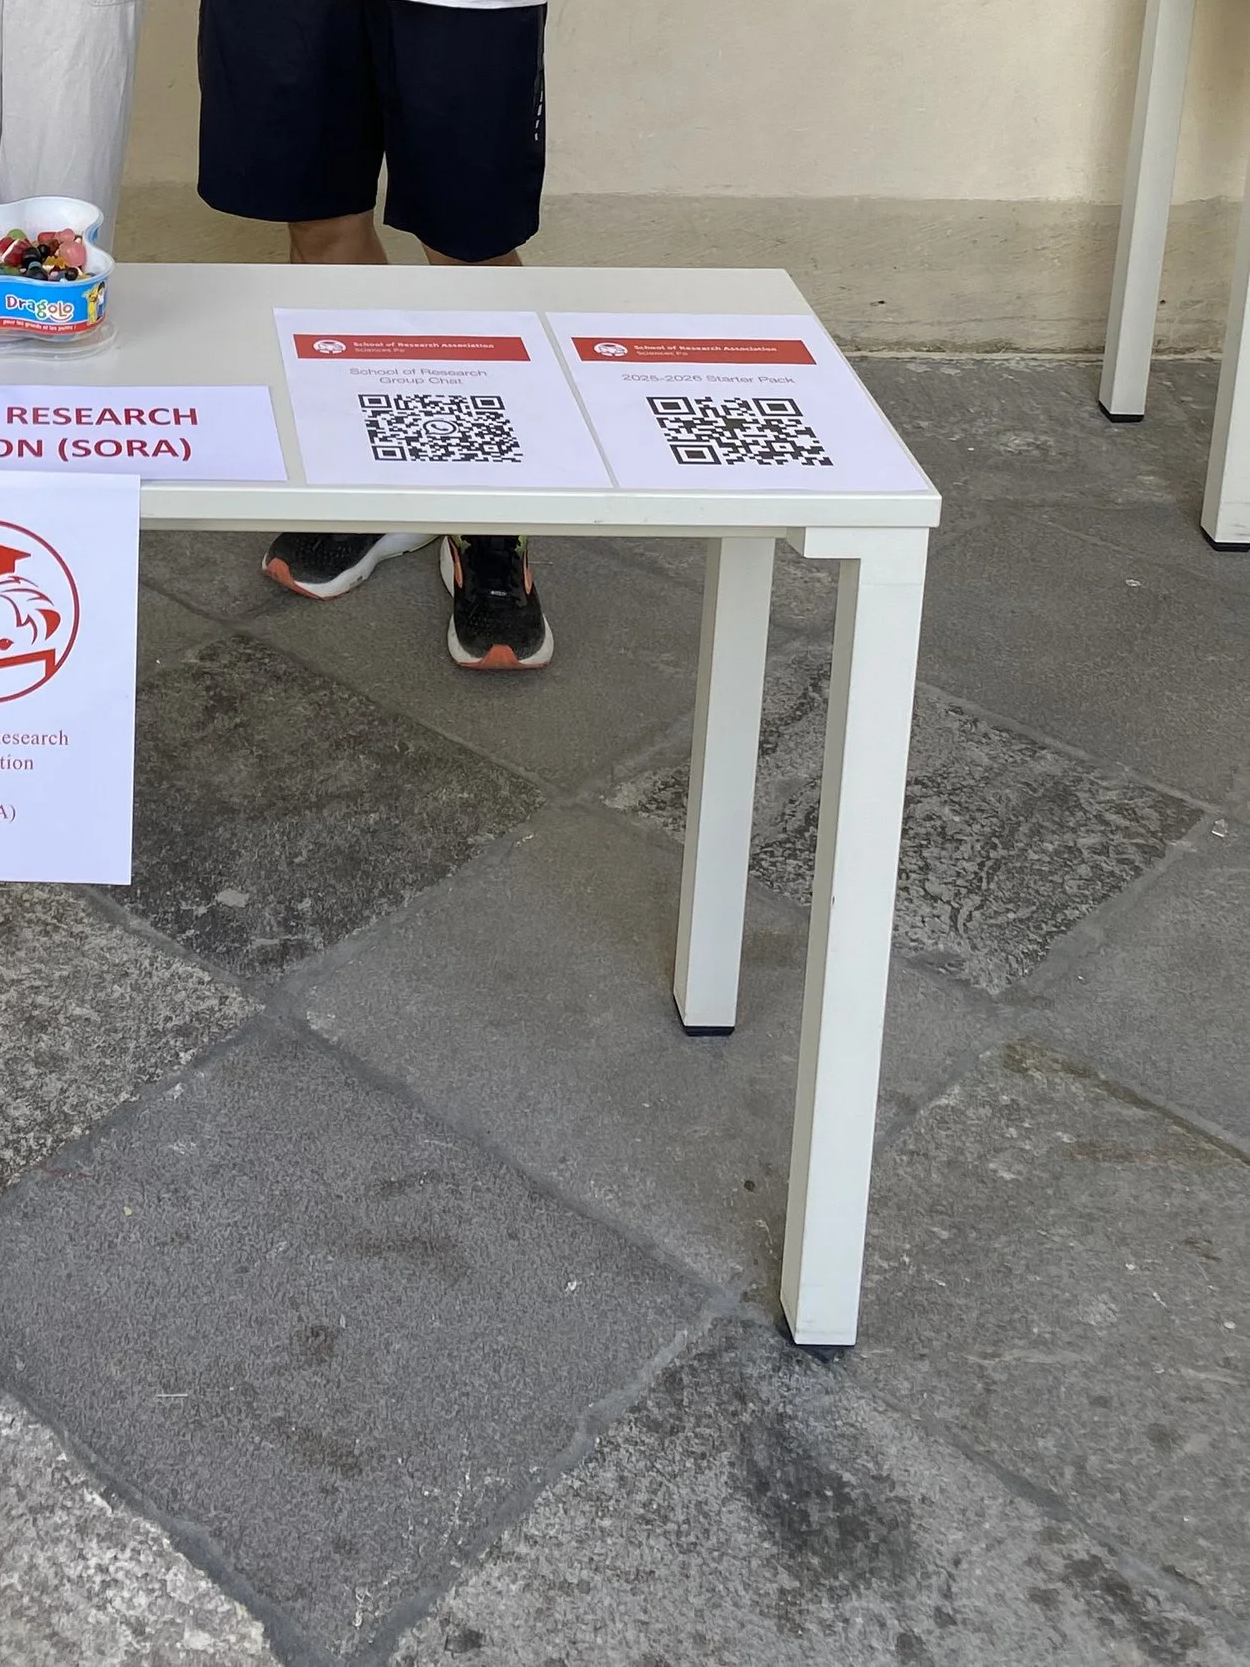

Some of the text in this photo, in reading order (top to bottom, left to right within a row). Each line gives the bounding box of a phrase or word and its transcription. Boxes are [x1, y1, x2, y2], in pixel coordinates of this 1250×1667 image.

[350, 368, 488, 377] School of Research
[379, 376, 463, 385] Group Chat
[621, 373, 796, 384] 2025-2026 Starter Pack
[6, 406, 198, 426] RESEARCH
[57, 437, 192, 463] (SORA)
